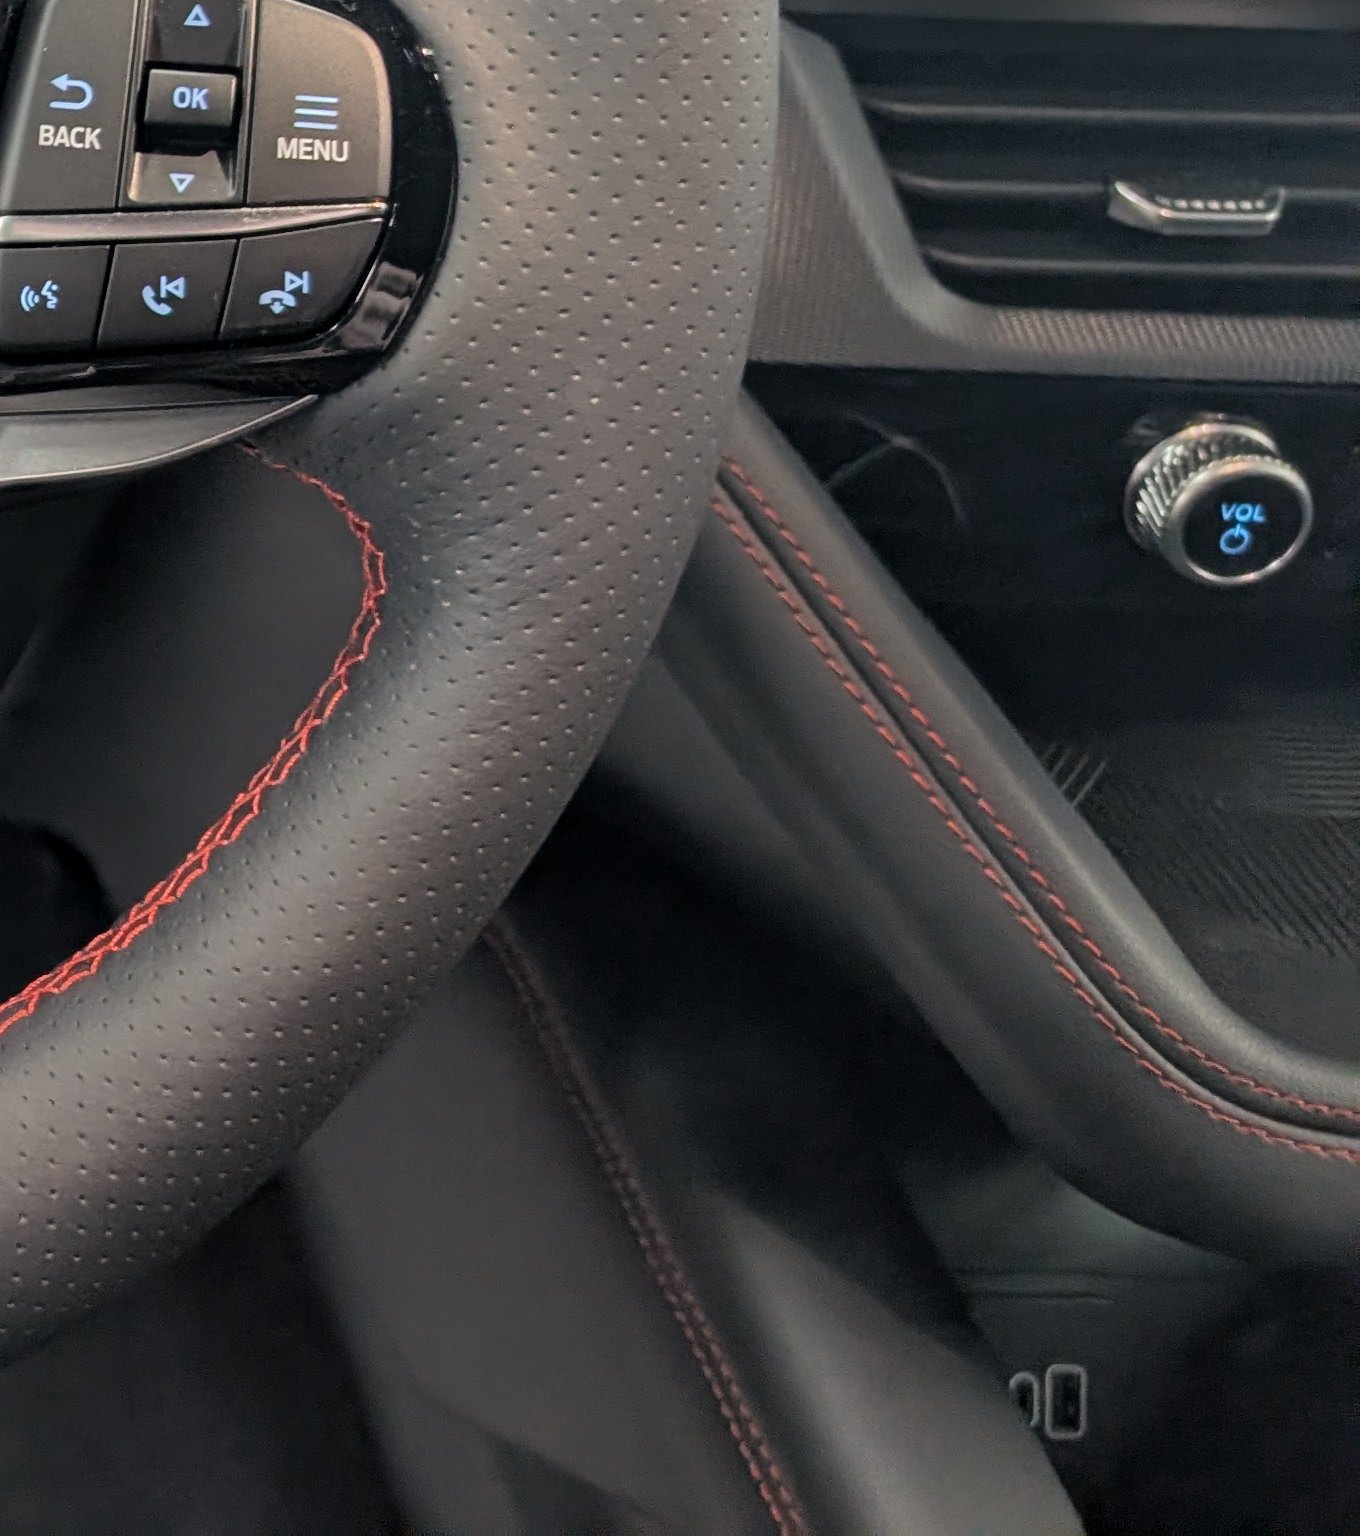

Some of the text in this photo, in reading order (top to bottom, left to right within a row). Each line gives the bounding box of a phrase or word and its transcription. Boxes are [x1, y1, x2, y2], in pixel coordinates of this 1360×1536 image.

[172, 86, 209, 111] OK
[38, 124, 102, 151] BACK
[276, 137, 349, 163] MENU
[1220, 502, 1267, 523] VOL
